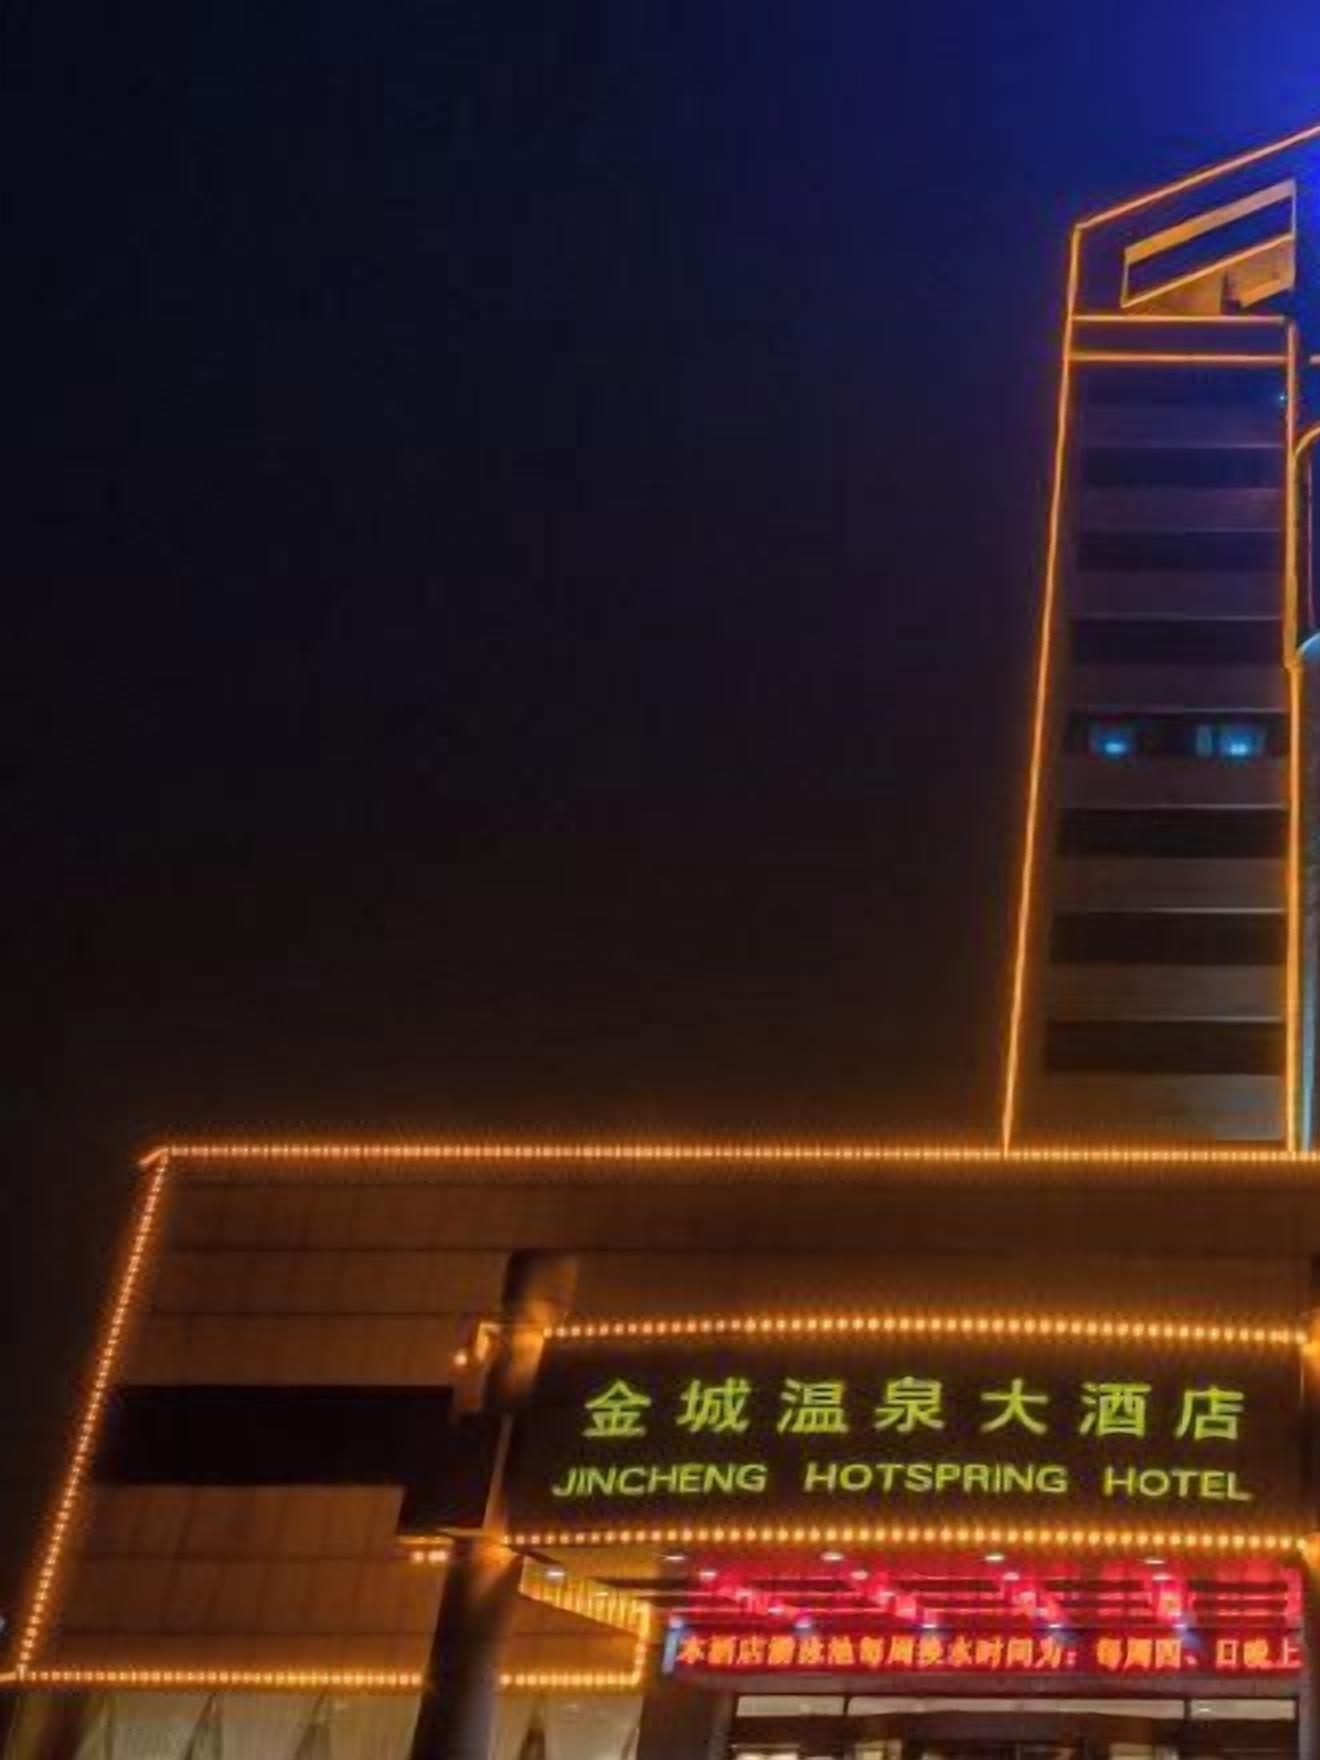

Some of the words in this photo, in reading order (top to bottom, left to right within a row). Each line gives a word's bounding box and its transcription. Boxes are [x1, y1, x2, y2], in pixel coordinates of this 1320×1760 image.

[583, 1376, 1246, 1441] 金城温泉大酒店
[552, 1463, 768, 1497] JINCHENG
[804, 1462, 1068, 1494] HOTSPRING
[1103, 1465, 1252, 1501] HOTEL
